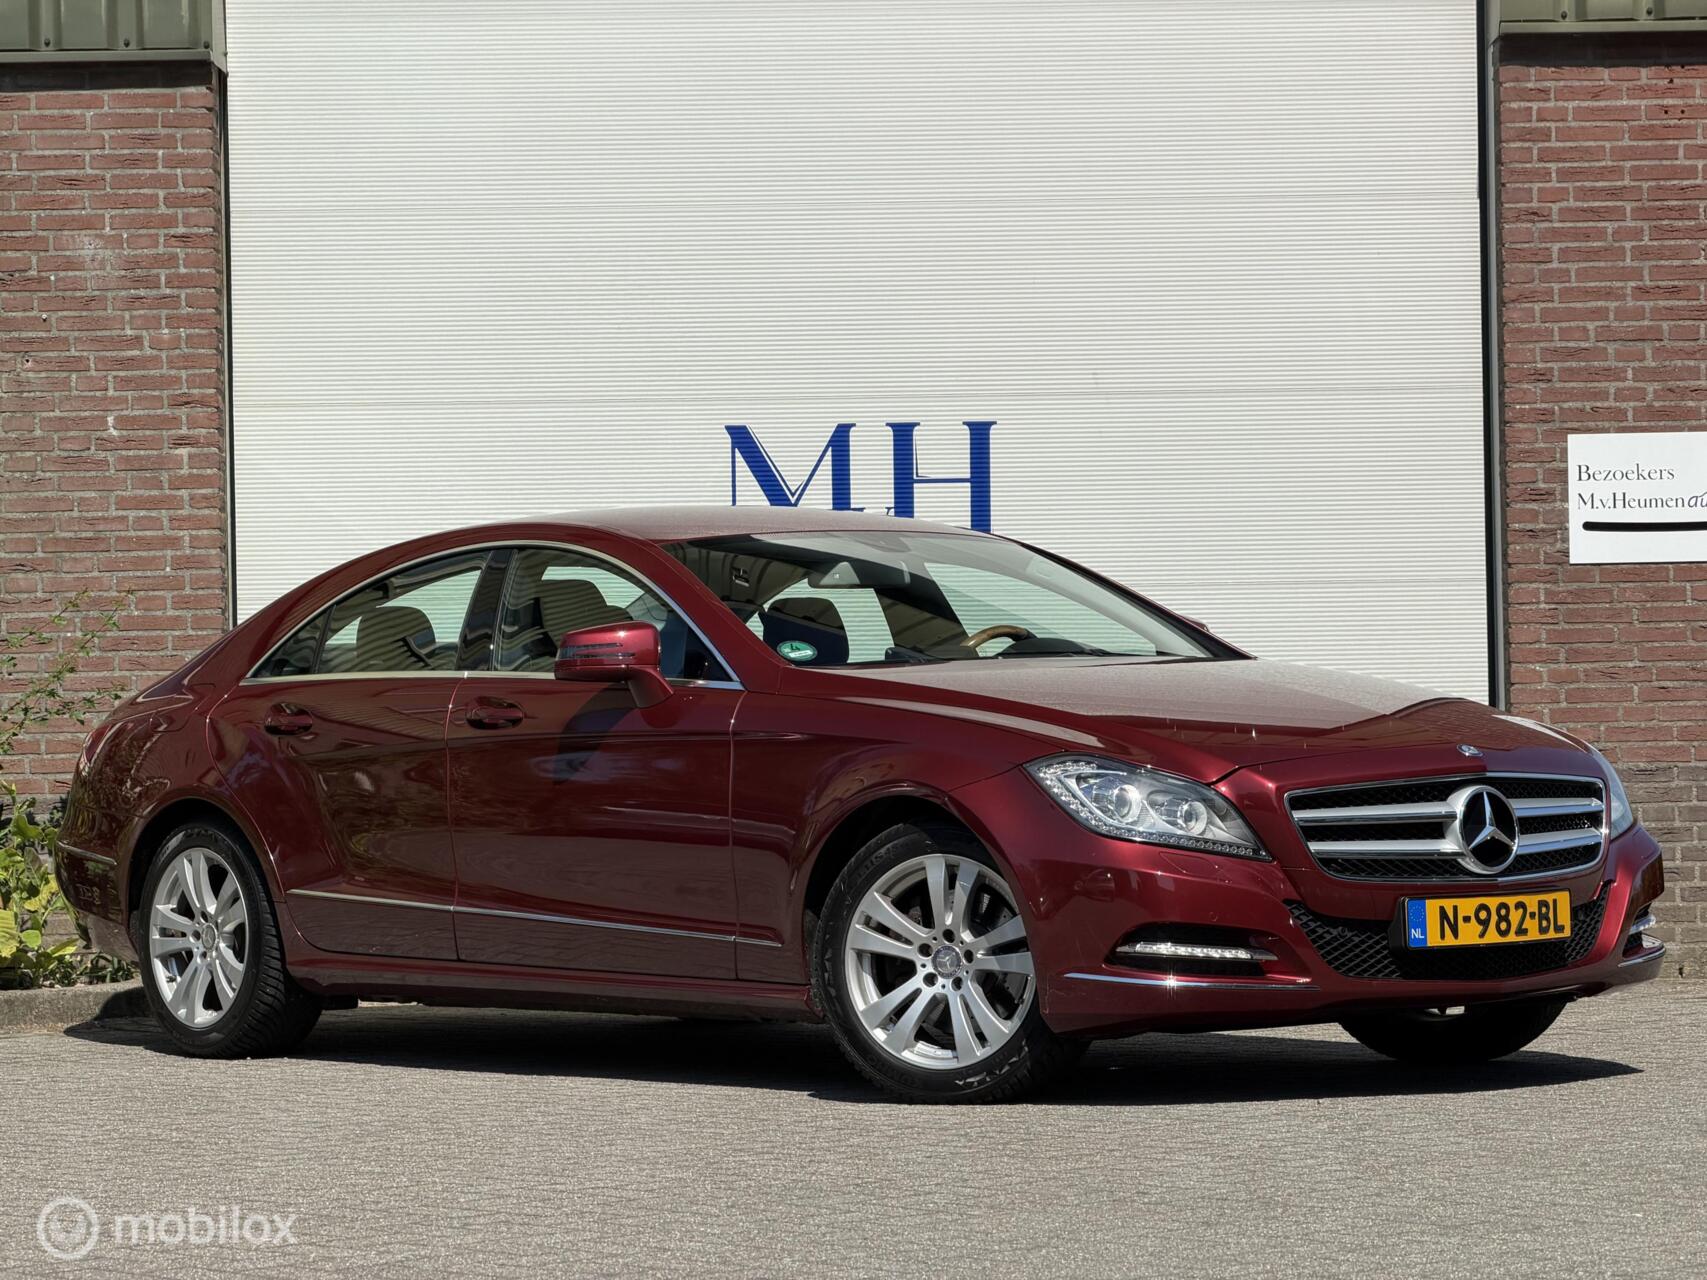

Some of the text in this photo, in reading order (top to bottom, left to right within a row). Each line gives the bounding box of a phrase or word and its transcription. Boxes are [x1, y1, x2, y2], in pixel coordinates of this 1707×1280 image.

[724, 421, 997, 533] MH
[1576, 463, 1675, 481] Bezoekers
[1411, 928, 1425, 939] NL
[1439, 898, 1565, 940] N-982-BL
